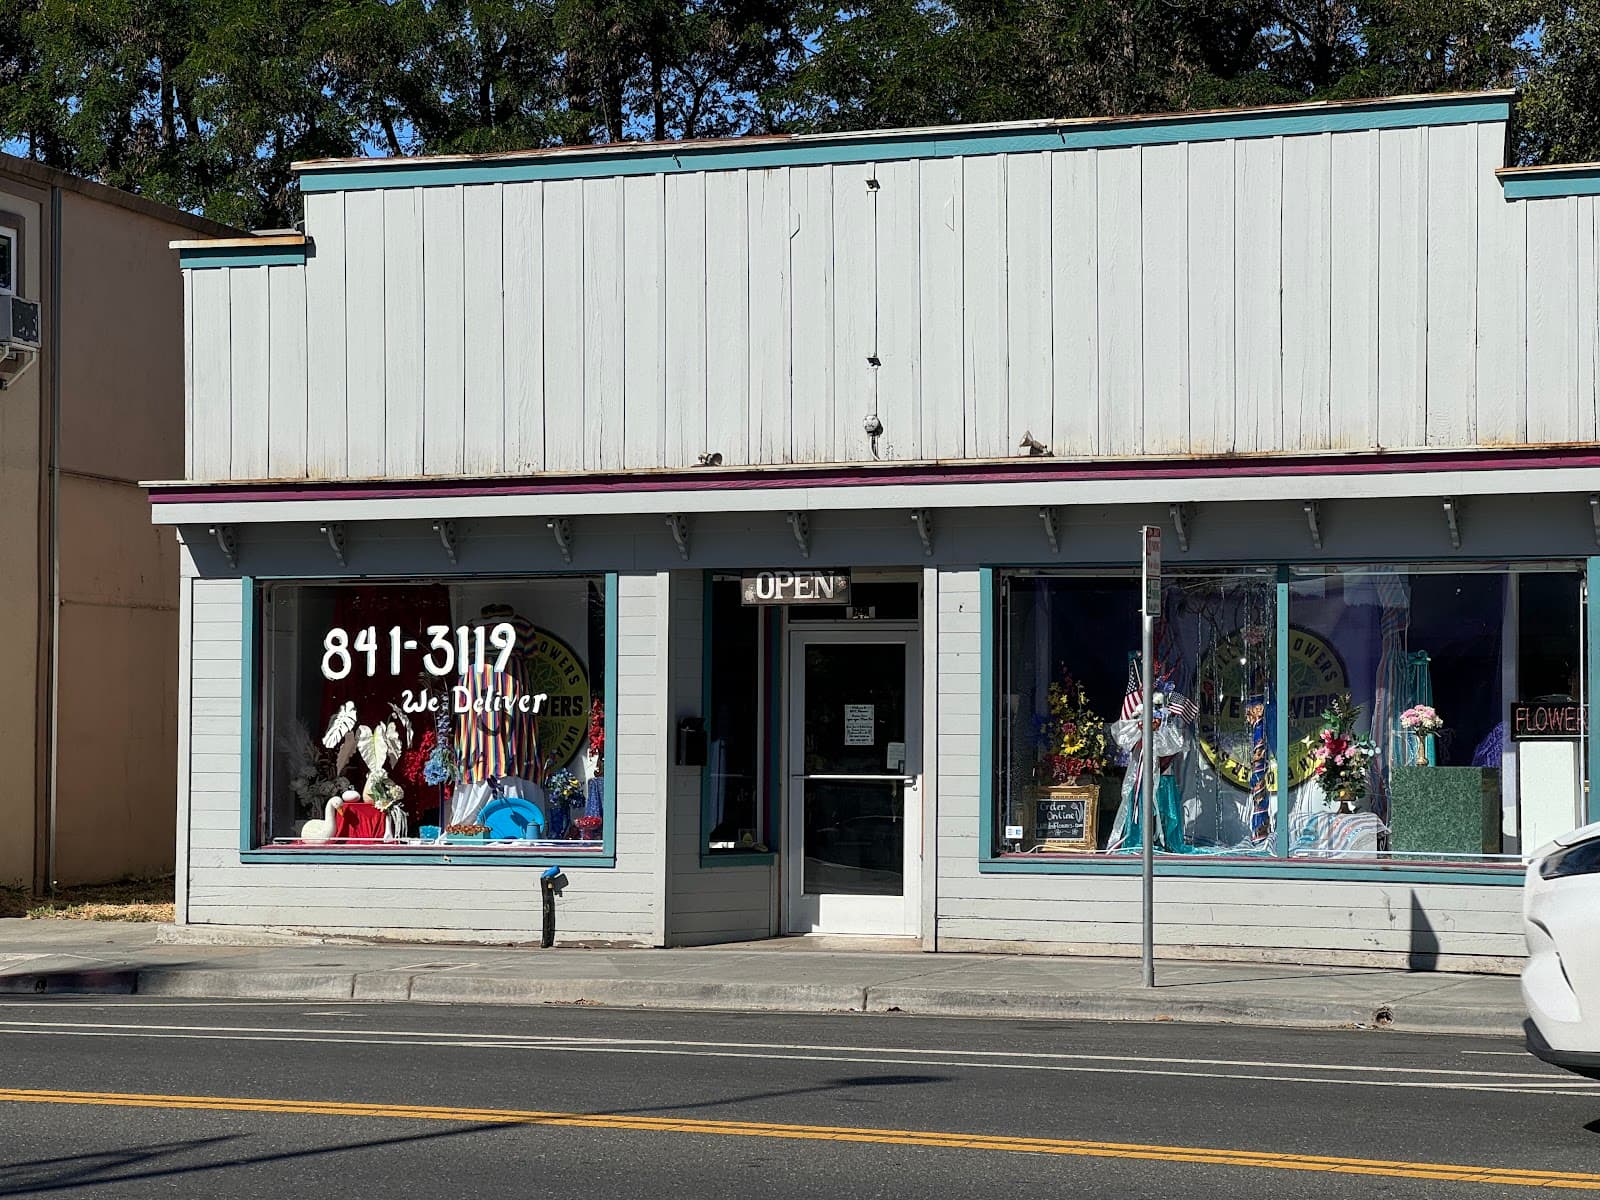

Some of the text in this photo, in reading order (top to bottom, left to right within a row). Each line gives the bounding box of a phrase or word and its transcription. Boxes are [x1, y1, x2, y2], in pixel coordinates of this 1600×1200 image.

[756, 570, 835, 600] OPEN
[321, 622, 517, 680] 841-3119
[540, 640, 581, 686] OWERS
[1293, 637, 1339, 683] OWERS
[401, 684, 548, 714] We Deliver
[1047, 811, 1076, 821] Online
